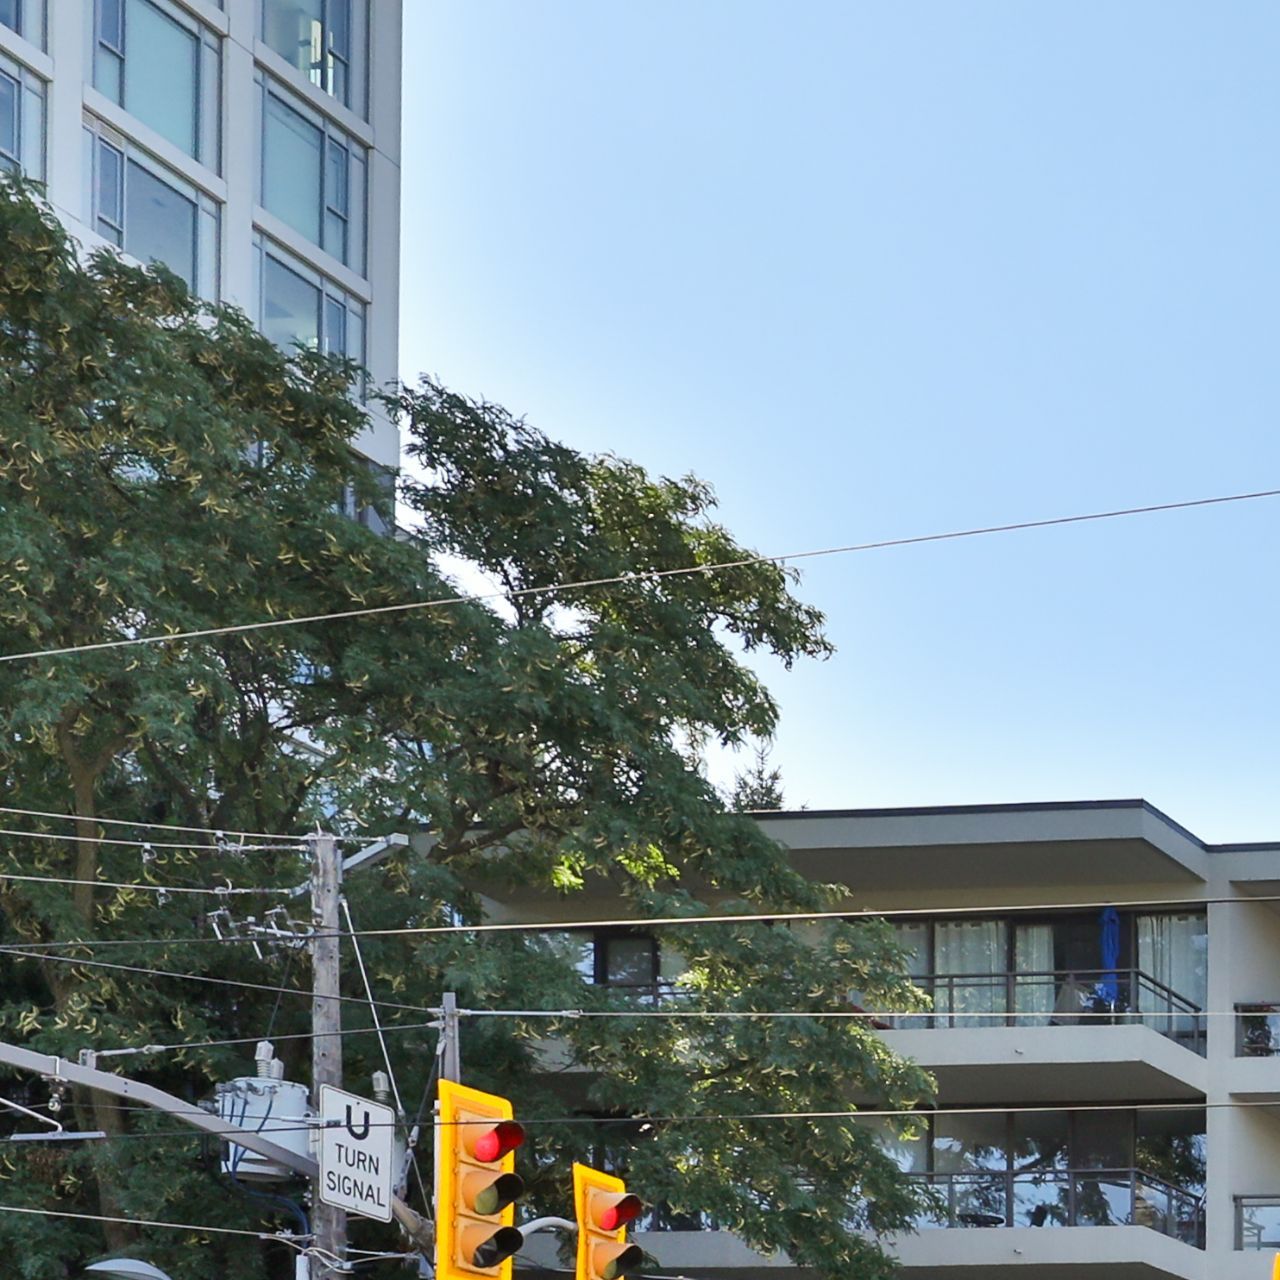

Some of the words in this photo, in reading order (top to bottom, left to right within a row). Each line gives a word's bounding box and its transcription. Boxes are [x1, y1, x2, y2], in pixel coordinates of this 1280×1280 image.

[345, 1104, 370, 1141] U
[335, 1143, 380, 1176] TURN
[326, 1170, 386, 1208] SIGNAL
